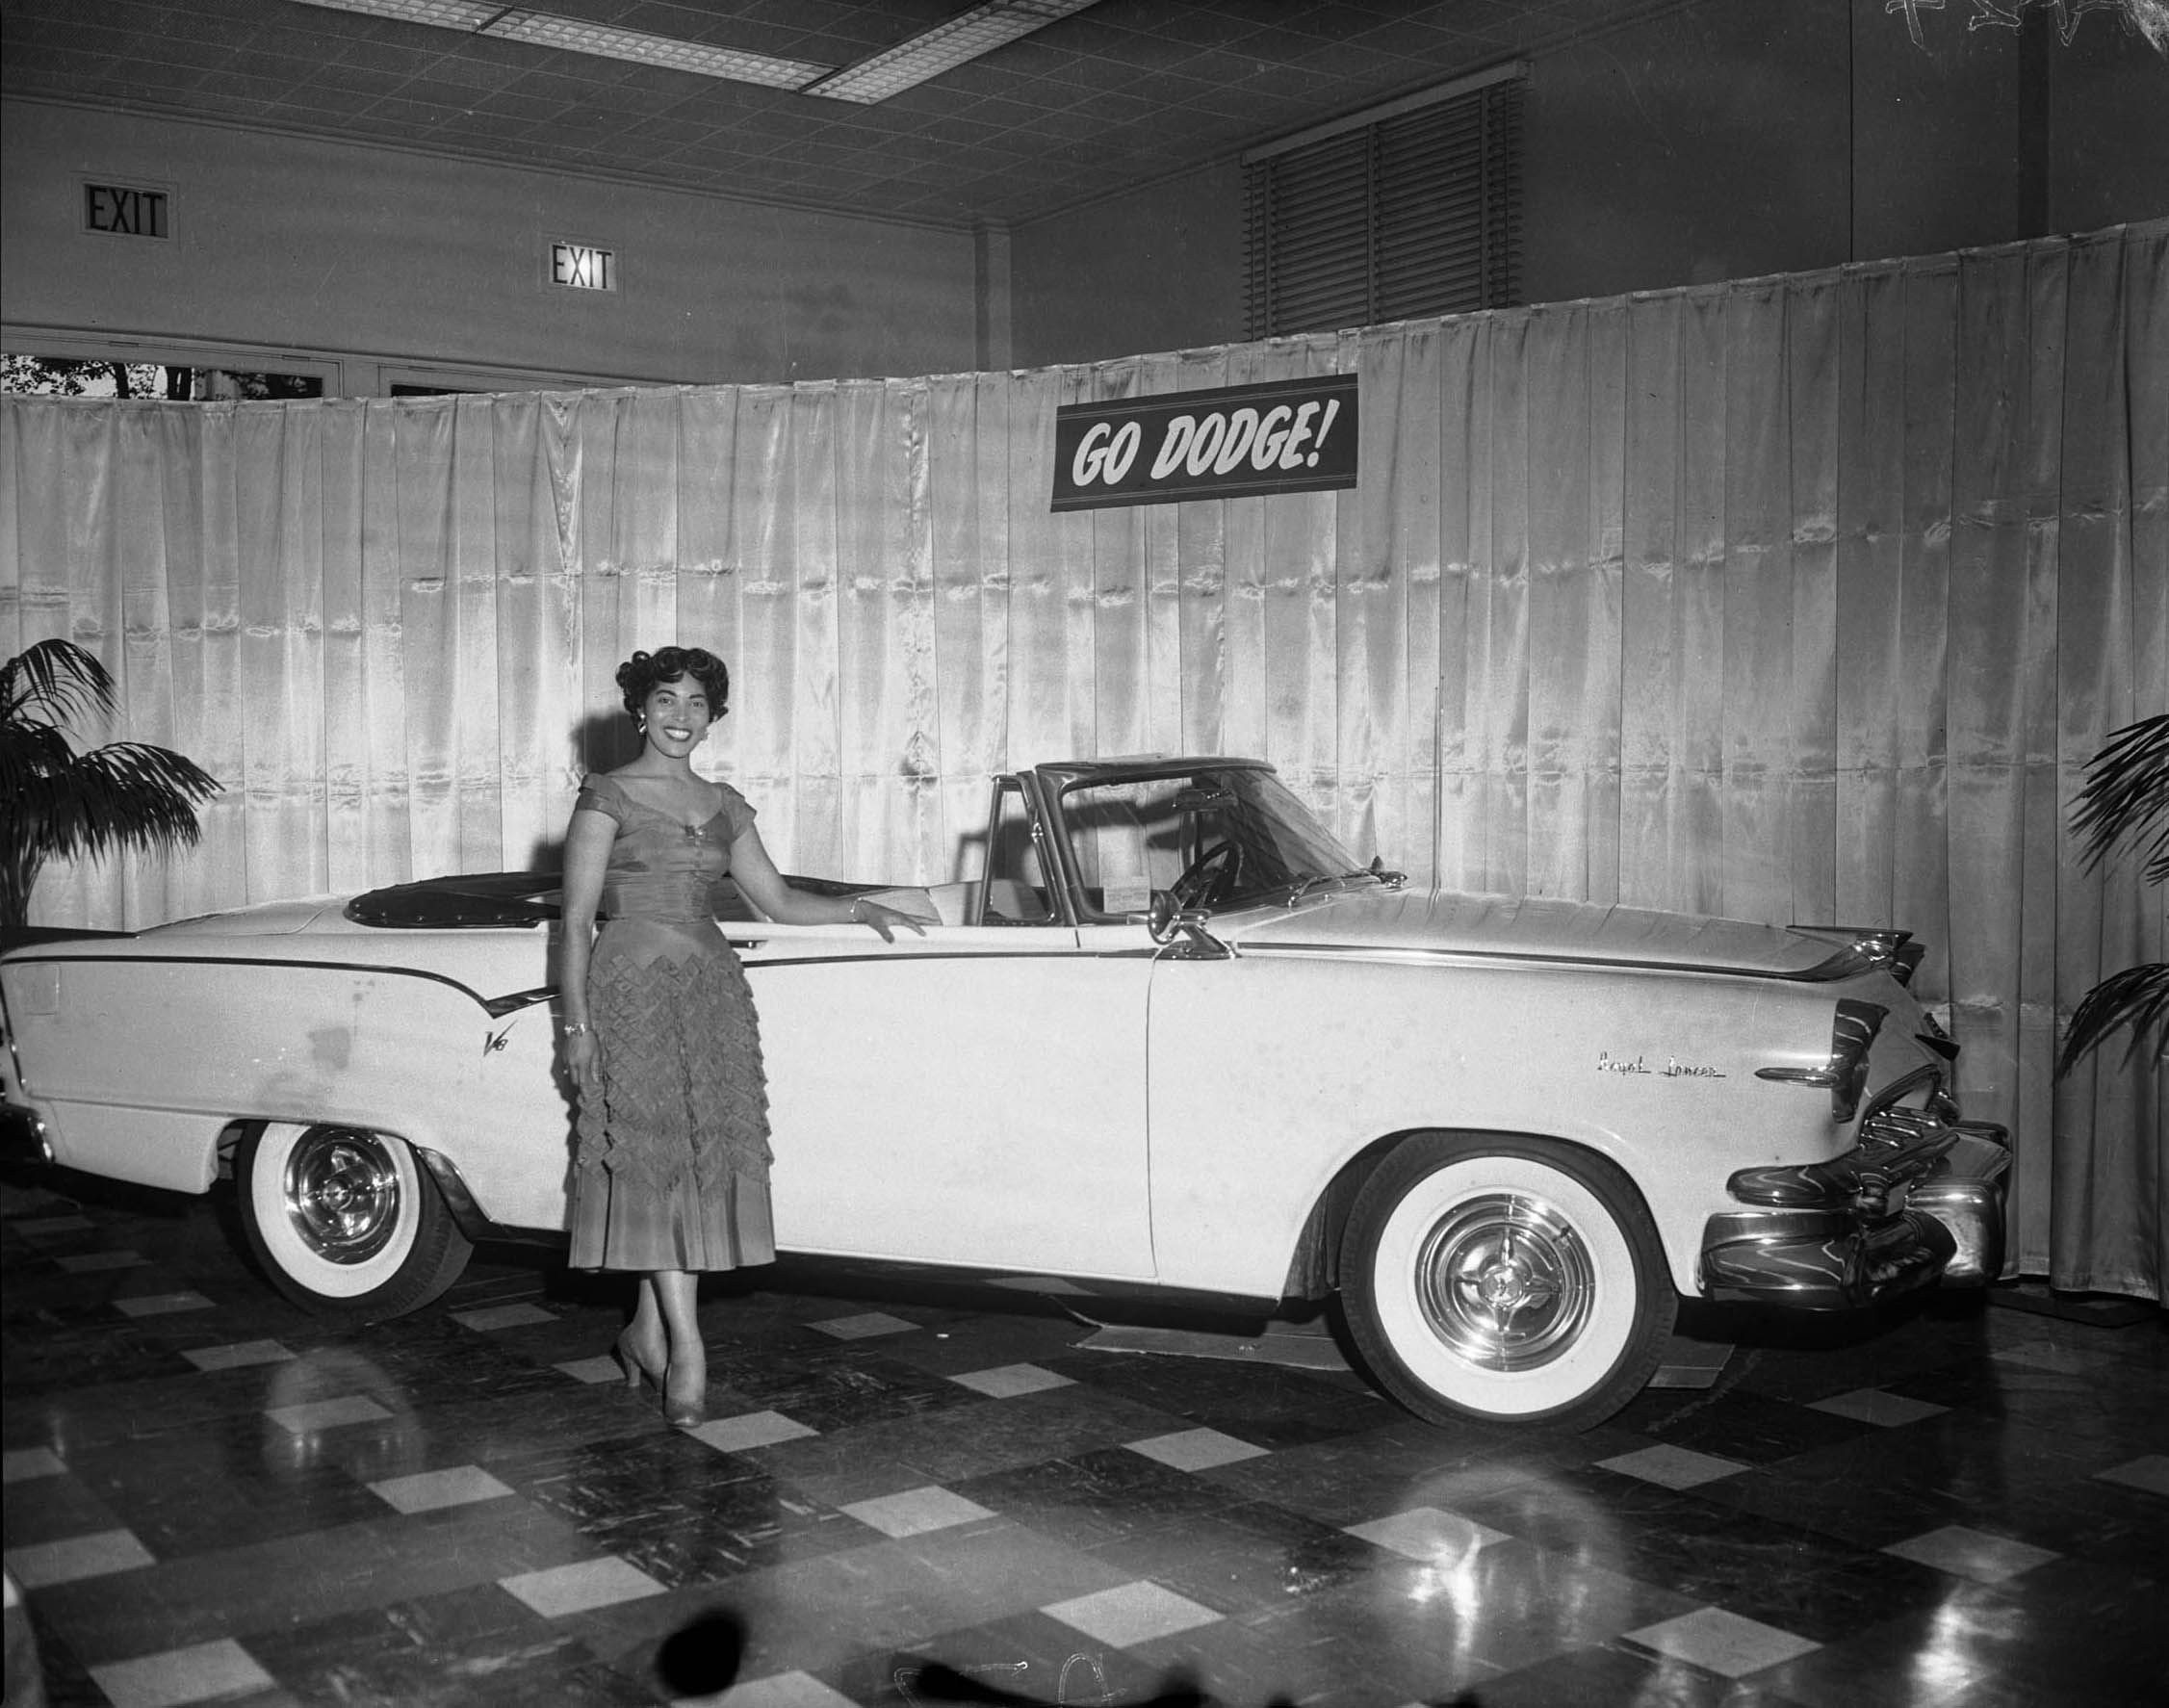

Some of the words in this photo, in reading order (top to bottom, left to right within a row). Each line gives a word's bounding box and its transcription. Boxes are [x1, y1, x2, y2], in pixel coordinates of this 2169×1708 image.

[90, 185, 164, 236] EXIT
[552, 244, 612, 289] EXIT
[1072, 422, 1142, 487] GO
[1149, 399, 1340, 480] DODGE!
